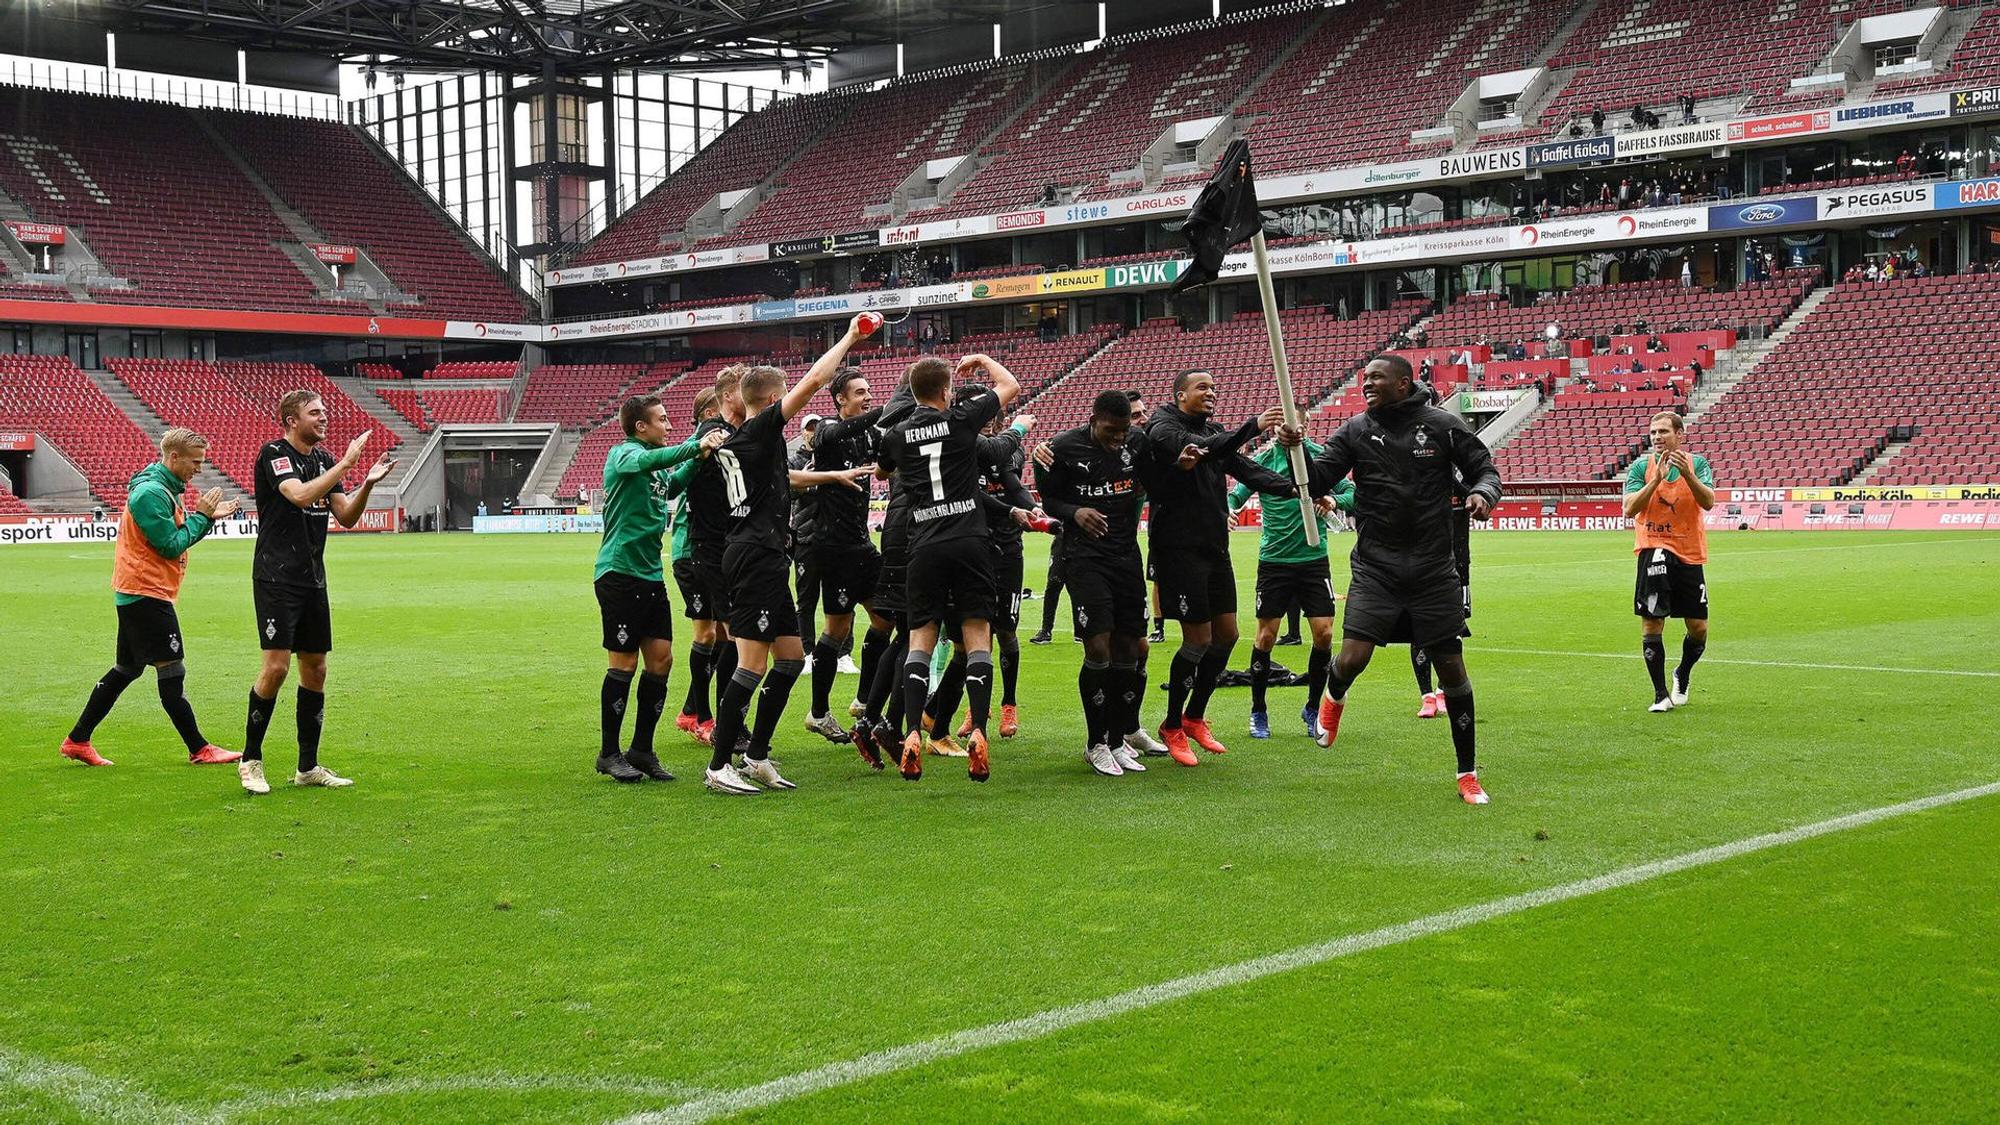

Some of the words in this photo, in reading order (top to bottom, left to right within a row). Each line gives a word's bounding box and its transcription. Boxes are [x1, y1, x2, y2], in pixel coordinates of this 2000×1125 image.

[1837, 101, 1914, 121] LIEBHERR
[1956, 104, 1999, 114] TEXTILDRUCK
[1618, 137, 1656, 152] GAFFELS
[1659, 128, 1721, 147] FASSBRAUSE
[1542, 147, 1571, 163] Gaffel
[1574, 142, 1609, 159] Kölsch
[1441, 152, 1520, 176] BAUWENS
[1365, 168, 1421, 183] dillenburger
[1126, 195, 1186, 212] CARGLASS
[1849, 188, 1926, 208] PEGASUS
[1067, 205, 1108, 221] stewe
[1748, 205, 1776, 220] Ford
[998, 213, 1041, 229] REMONDIS
[1639, 216, 1696, 230] RheinEnergie
[37, 225, 62, 234] SCHÄFER
[1541, 227, 1595, 239] RheinEnergie
[1424, 238, 1483, 251] Kreissparkasse
[1486, 235, 1504, 244] Köln
[661, 257, 675, 265] Rhein
[697, 254, 723, 263] RheinEnergie
[1268, 253, 1293, 265] rkasse
[1295, 251, 1333, 263] KölnBonn
[660, 263, 678, 271] Energie
[1219, 261, 1247, 272] ologne
[1055, 275, 1099, 287] RENAULT
[1115, 262, 1167, 287] DEVK
[996, 282, 1030, 295] Remagen
[918, 291, 958, 305] sunzinet
[798, 299, 848, 313] SIEGENIA
[488, 328, 522, 337] RheinEnergie
[590, 318, 660, 333] RheinEnergieSTADION
[905, 421, 950, 443] HERRMANN
[919, 442, 944, 501] 7
[913, 499, 976, 523] MÖNCHENGLADBACH
[1940, 513, 1985, 524] REWE
[360, 512, 388, 529] MARKT
[1499, 518, 1536, 529] REWE
[1541, 517, 1580, 529] REWE
[1585, 517, 1624, 529] REWE
[68, 524, 117, 541] uhlsp
